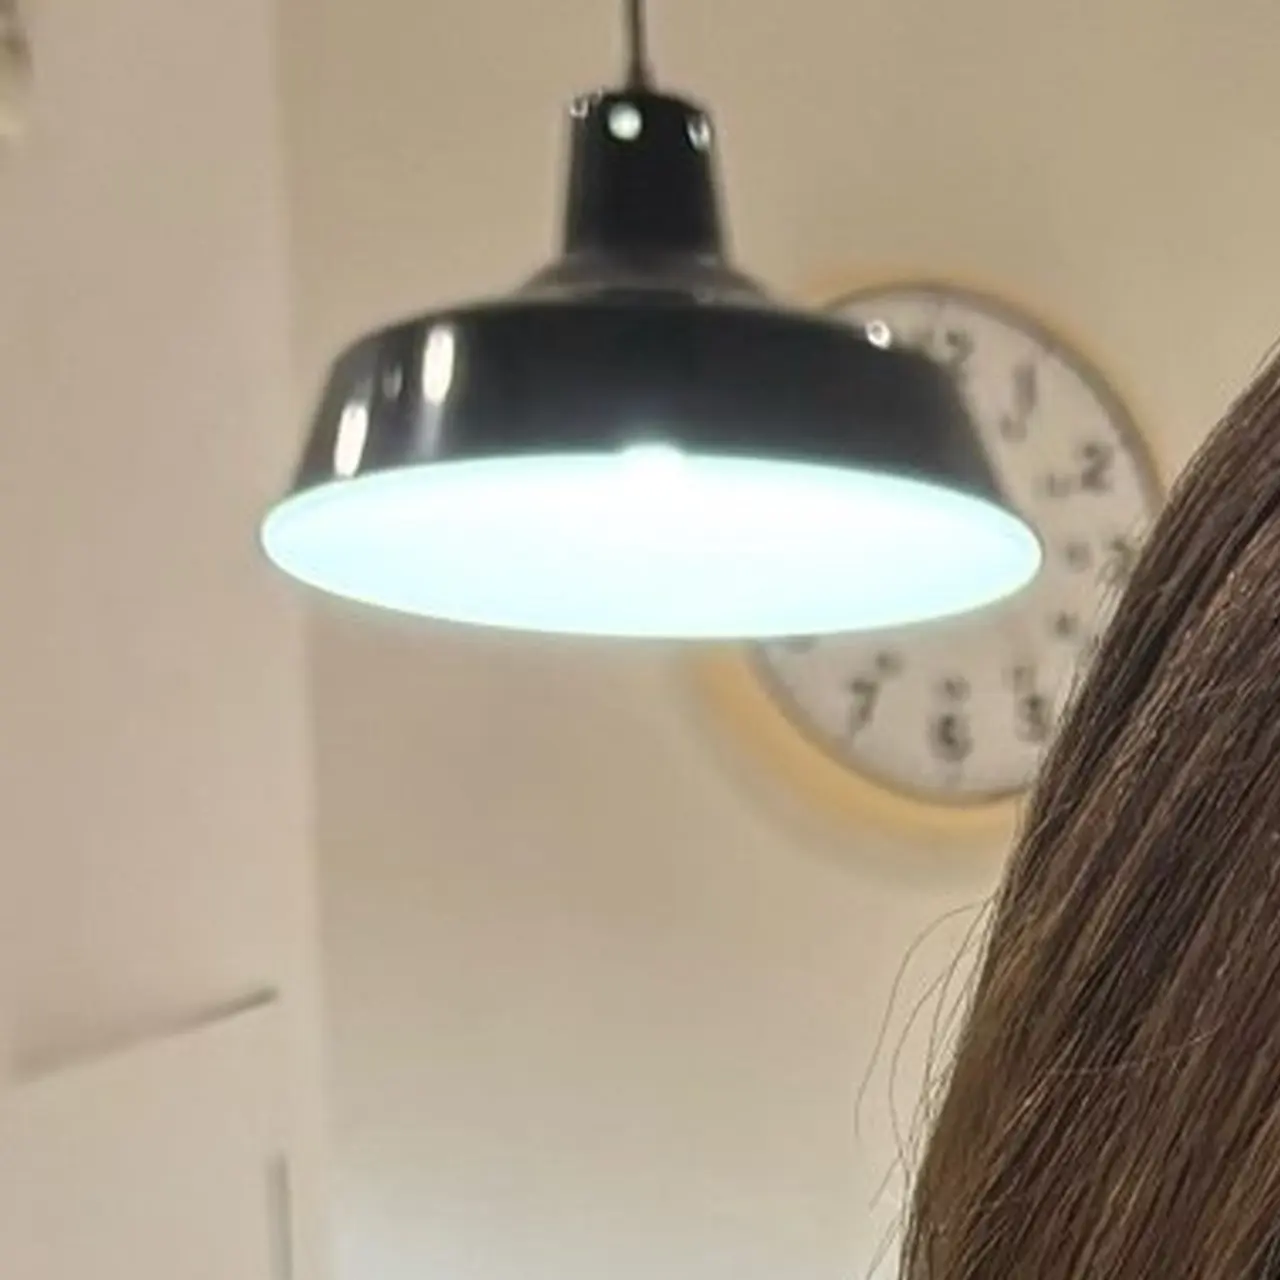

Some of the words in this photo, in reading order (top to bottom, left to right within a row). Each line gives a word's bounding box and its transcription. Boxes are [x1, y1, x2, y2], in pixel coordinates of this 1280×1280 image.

[1078, 443, 1114, 491] 2
[849, 675, 879, 740] 7
[930, 713, 974, 762] 6
